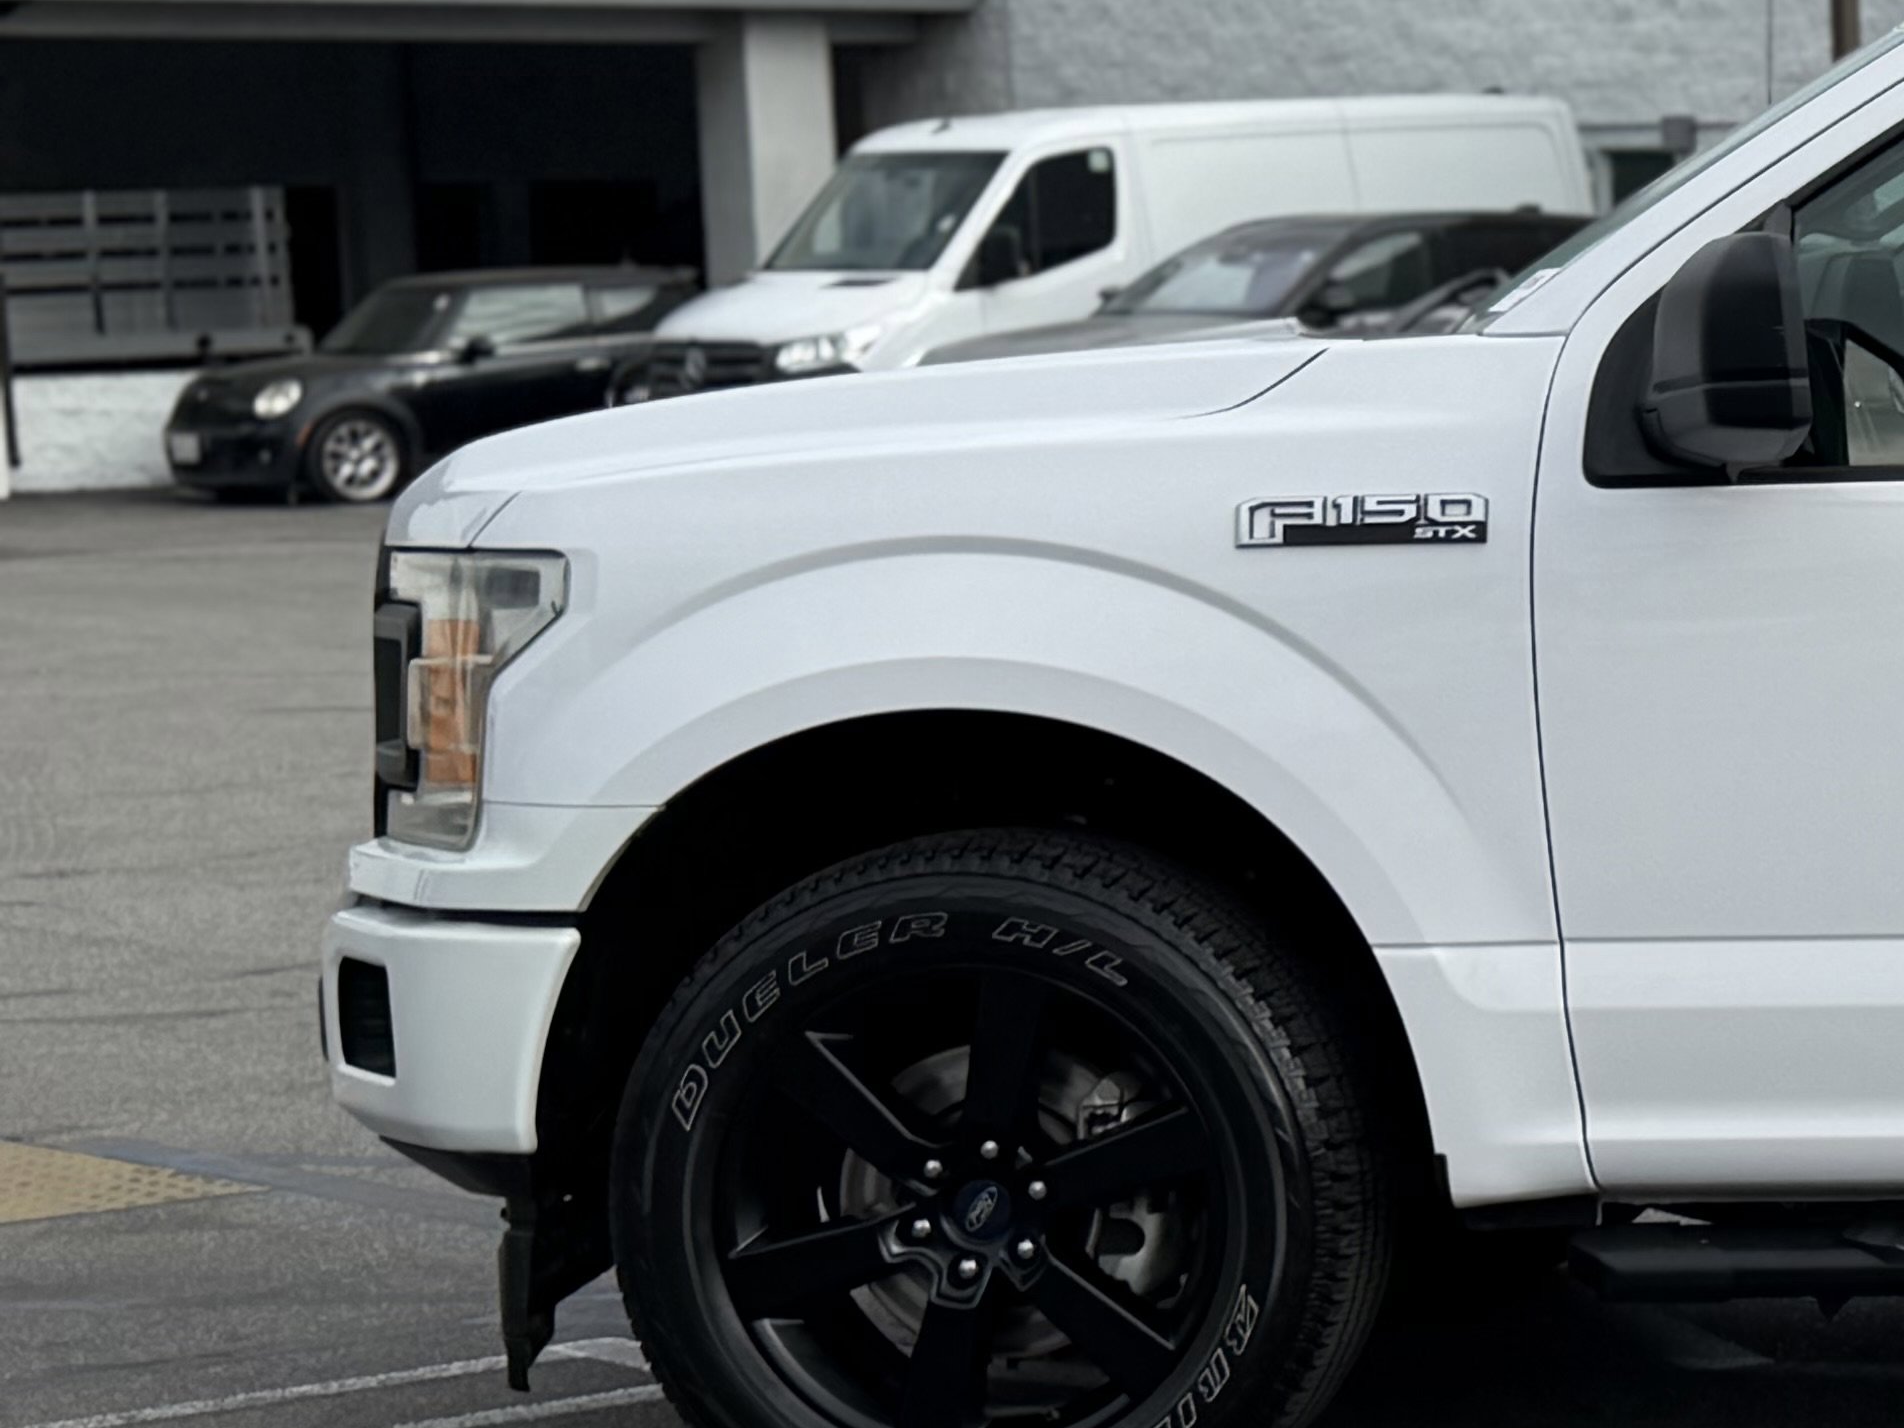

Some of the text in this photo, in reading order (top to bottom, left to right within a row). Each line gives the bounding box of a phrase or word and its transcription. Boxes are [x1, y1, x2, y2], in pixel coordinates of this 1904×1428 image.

[1412, 523, 1478, 540] STX
[670, 911, 1128, 1132] DUELER H/L
